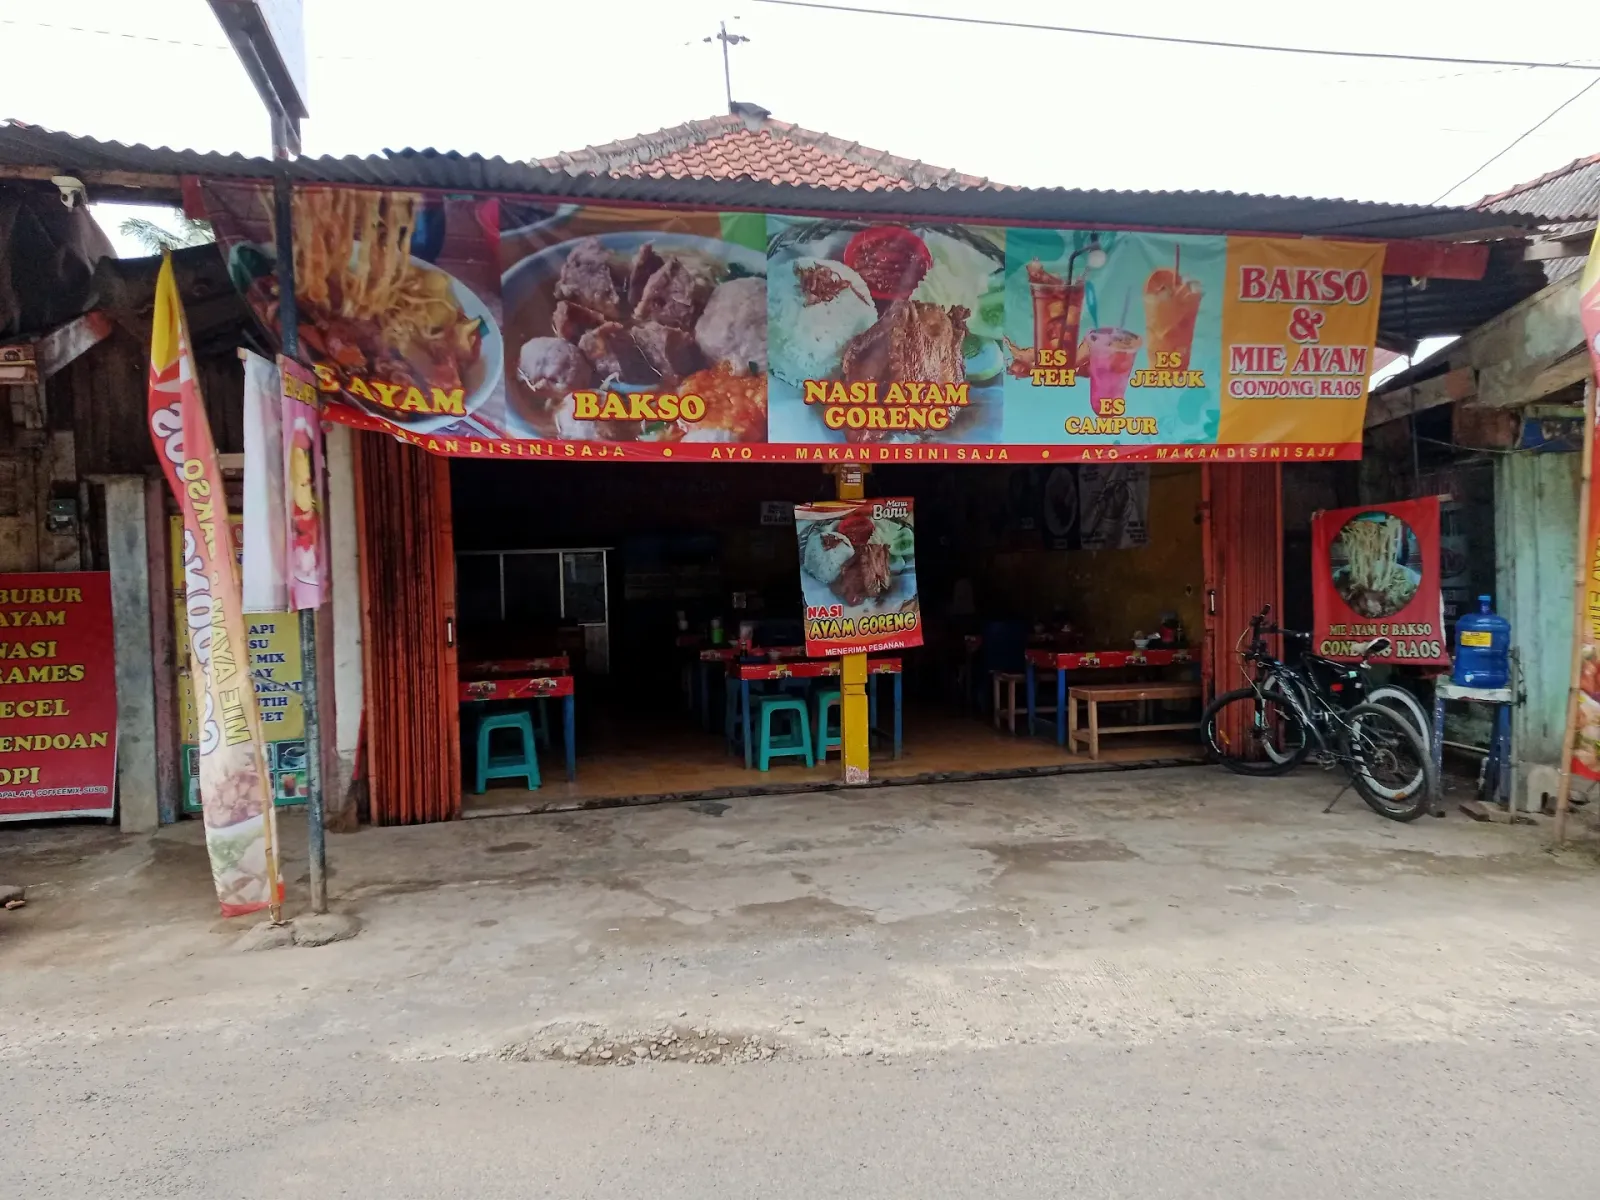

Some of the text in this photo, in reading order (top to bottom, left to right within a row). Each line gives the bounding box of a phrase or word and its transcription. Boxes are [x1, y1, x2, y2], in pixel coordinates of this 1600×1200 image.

[1240, 266, 1371, 303] BAKSO
[1288, 305, 1324, 342] &
[1038, 349, 1067, 367] ES
[1155, 351, 1182, 369] ES
[1229, 345, 1367, 376] MIE AYAM
[1030, 368, 1076, 387] TEH
[1130, 370, 1205, 388] JERUK
[349, 375, 466, 416] AYAM
[803, 380, 970, 405] NASI AYAM
[1229, 379, 1363, 399] CONDONG RAOS
[574, 391, 706, 421] BAKSO
[1098, 398, 1126, 416] ES
[824, 406, 949, 430] GORENG
[1065, 416, 1158, 435] CAMPUR
[470, 442, 555, 457] DISINI
[565, 445, 625, 458] SAJA
[710, 446, 753, 459] AYO
[795, 447, 871, 460] MAKAN
[880, 448, 949, 460] DISINI
[957, 448, 1009, 460] SAJA
[1081, 449, 1119, 460] AYO
[1156, 448, 1219, 459] MAKAN
[1227, 447, 1289, 458] DISINI
[1295, 447, 1336, 458] SAJA
[807, 604, 843, 619] NASI
[249, 624, 275, 635] API
[809, 612, 917, 640] AYAM GORENG
[1329, 624, 1347, 636] MIE
[1349, 624, 1378, 636] AYAM
[1391, 623, 1432, 636] BAKSO
[256, 653, 286, 663] MIX
[825, 641, 905, 656] MENERIMA PESANAN
[1396, 640, 1441, 658] RAOS
[0, 664, 85, 684] AMES
